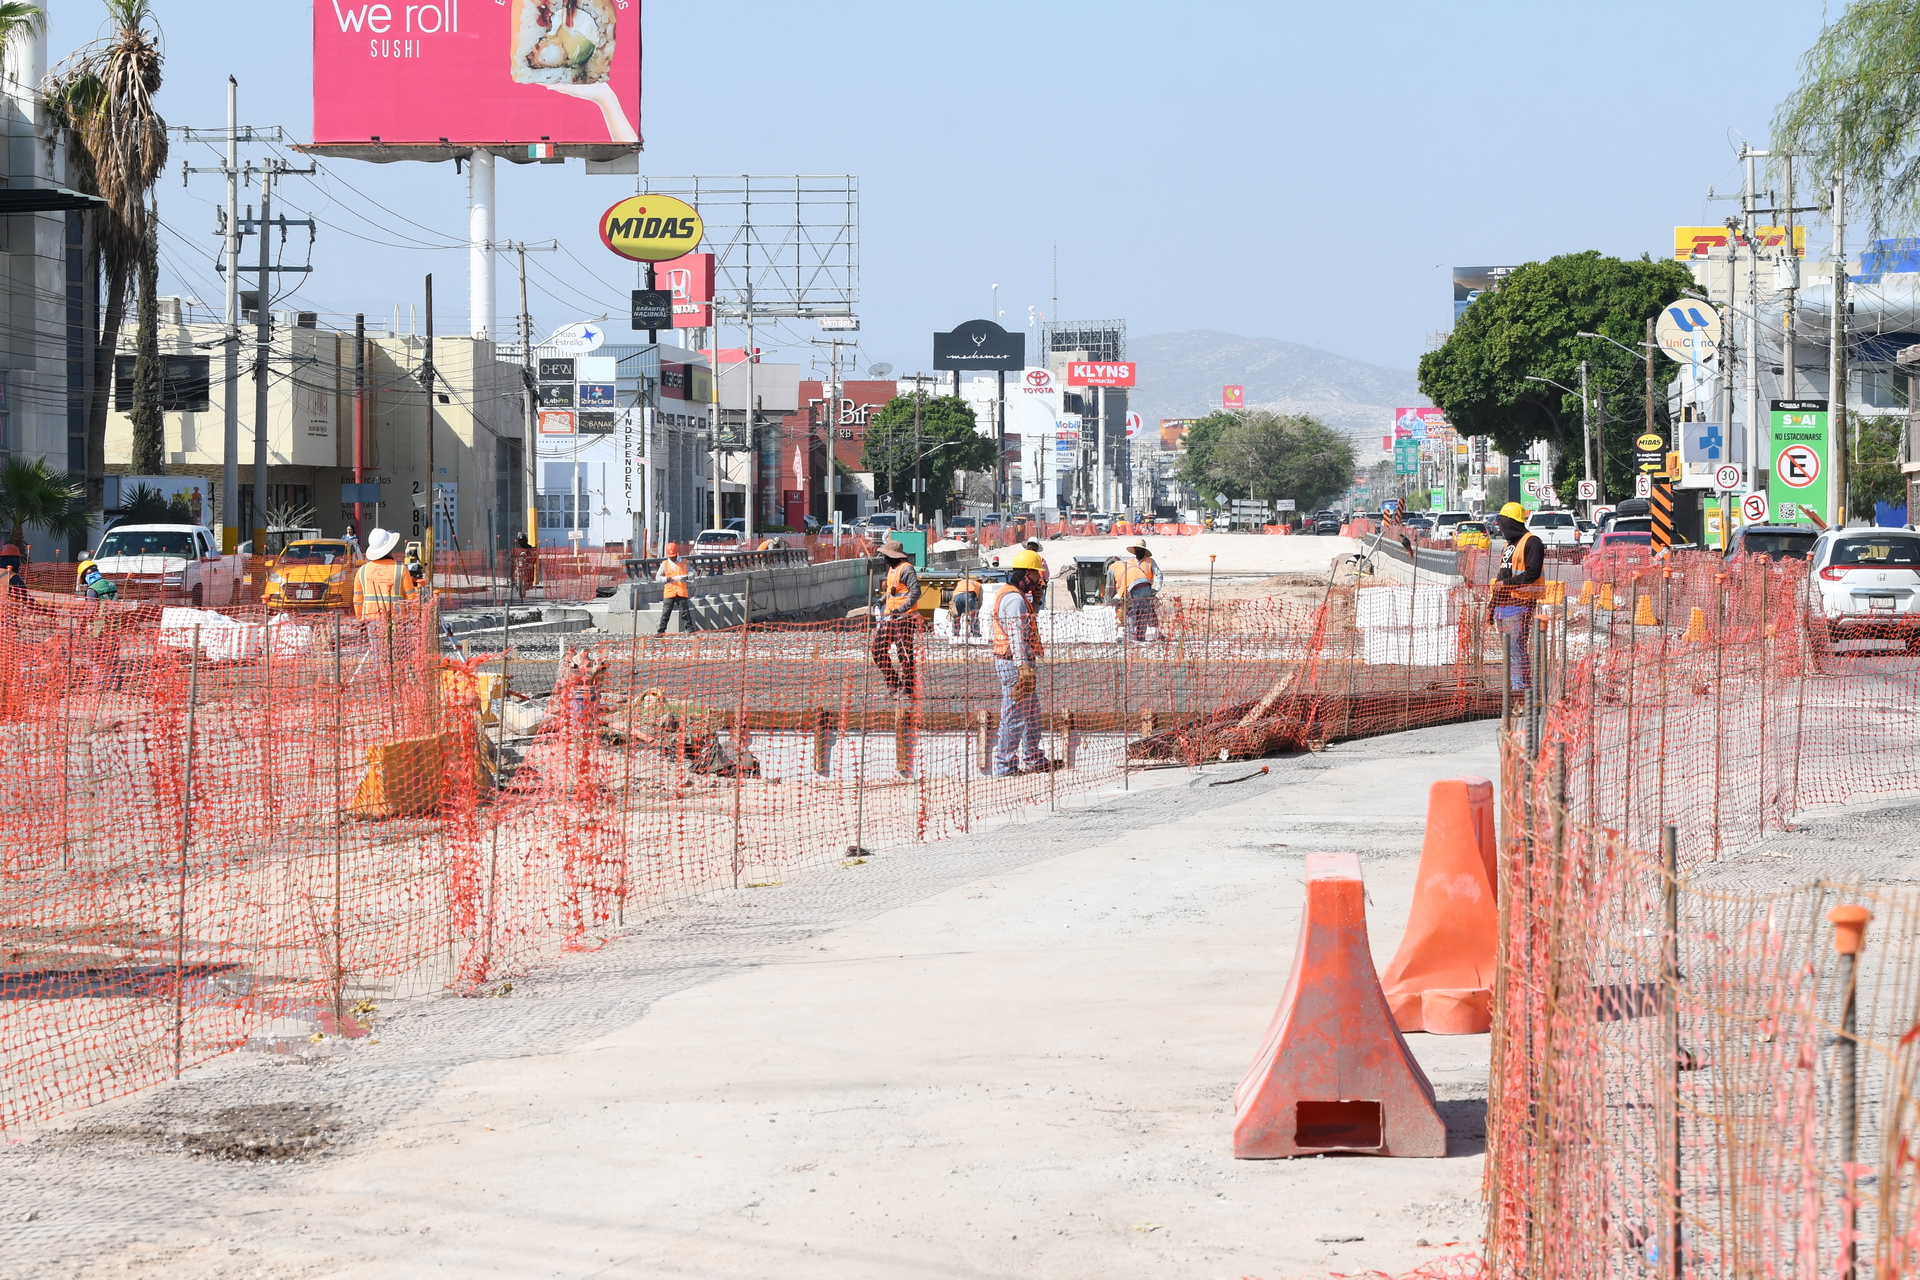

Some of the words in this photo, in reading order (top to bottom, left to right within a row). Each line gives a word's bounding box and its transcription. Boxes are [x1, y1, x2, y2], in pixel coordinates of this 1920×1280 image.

[406, 0, 458, 33] roll
[370, 39, 420, 58] SUSHI
[608, 207, 695, 241] MIDAS
[673, 304, 700, 314] NDA
[823, 319, 852, 327] Vendor
[1073, 365, 1129, 378] KLYNS
[1790, 455, 1807, 477] E
[1721, 470, 1735, 480] 30
[341, 510, 372, 520] Posers
[412, 481, 420, 537] 280
